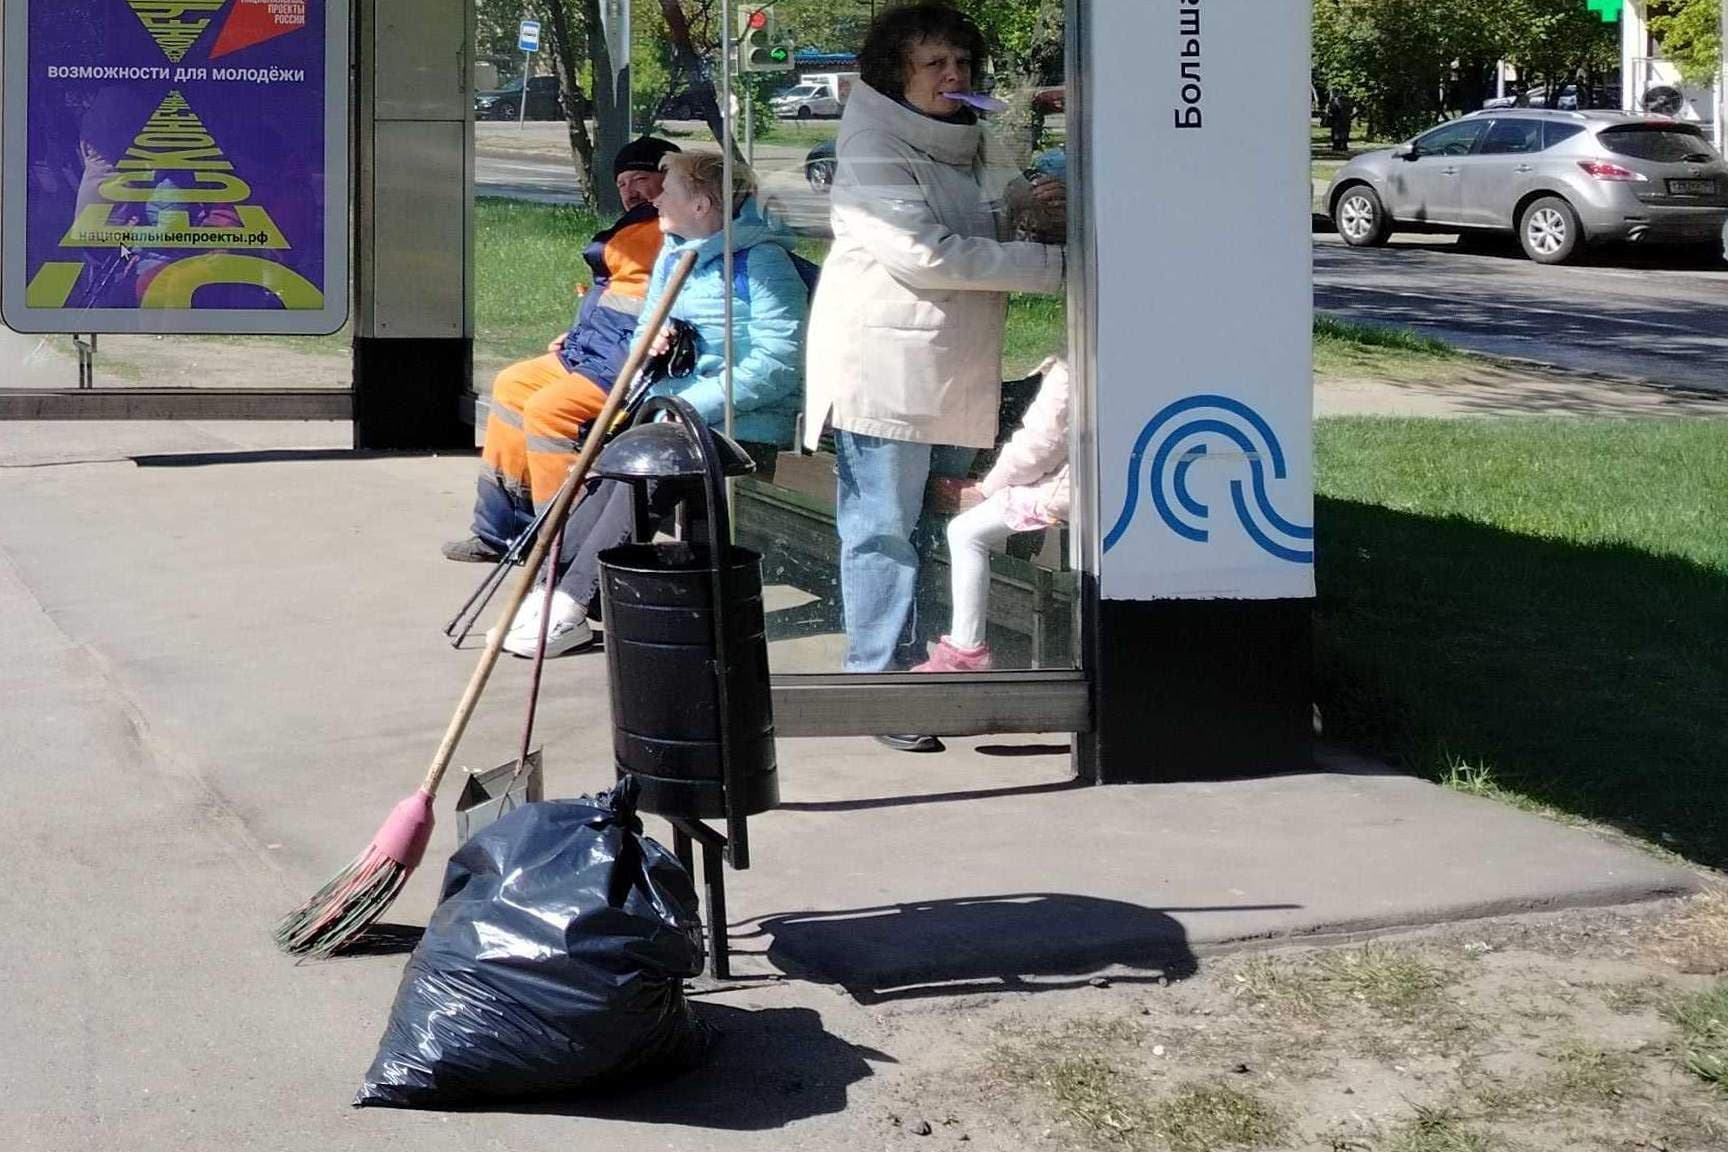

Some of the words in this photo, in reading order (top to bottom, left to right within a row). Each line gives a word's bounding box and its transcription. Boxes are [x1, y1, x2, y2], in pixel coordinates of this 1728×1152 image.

[268, 4, 305, 14] ПРОЕКТЫ
[274, 14, 305, 24] РОССИИ
[47, 66, 170, 80] возможности
[174, 67, 207, 82] для
